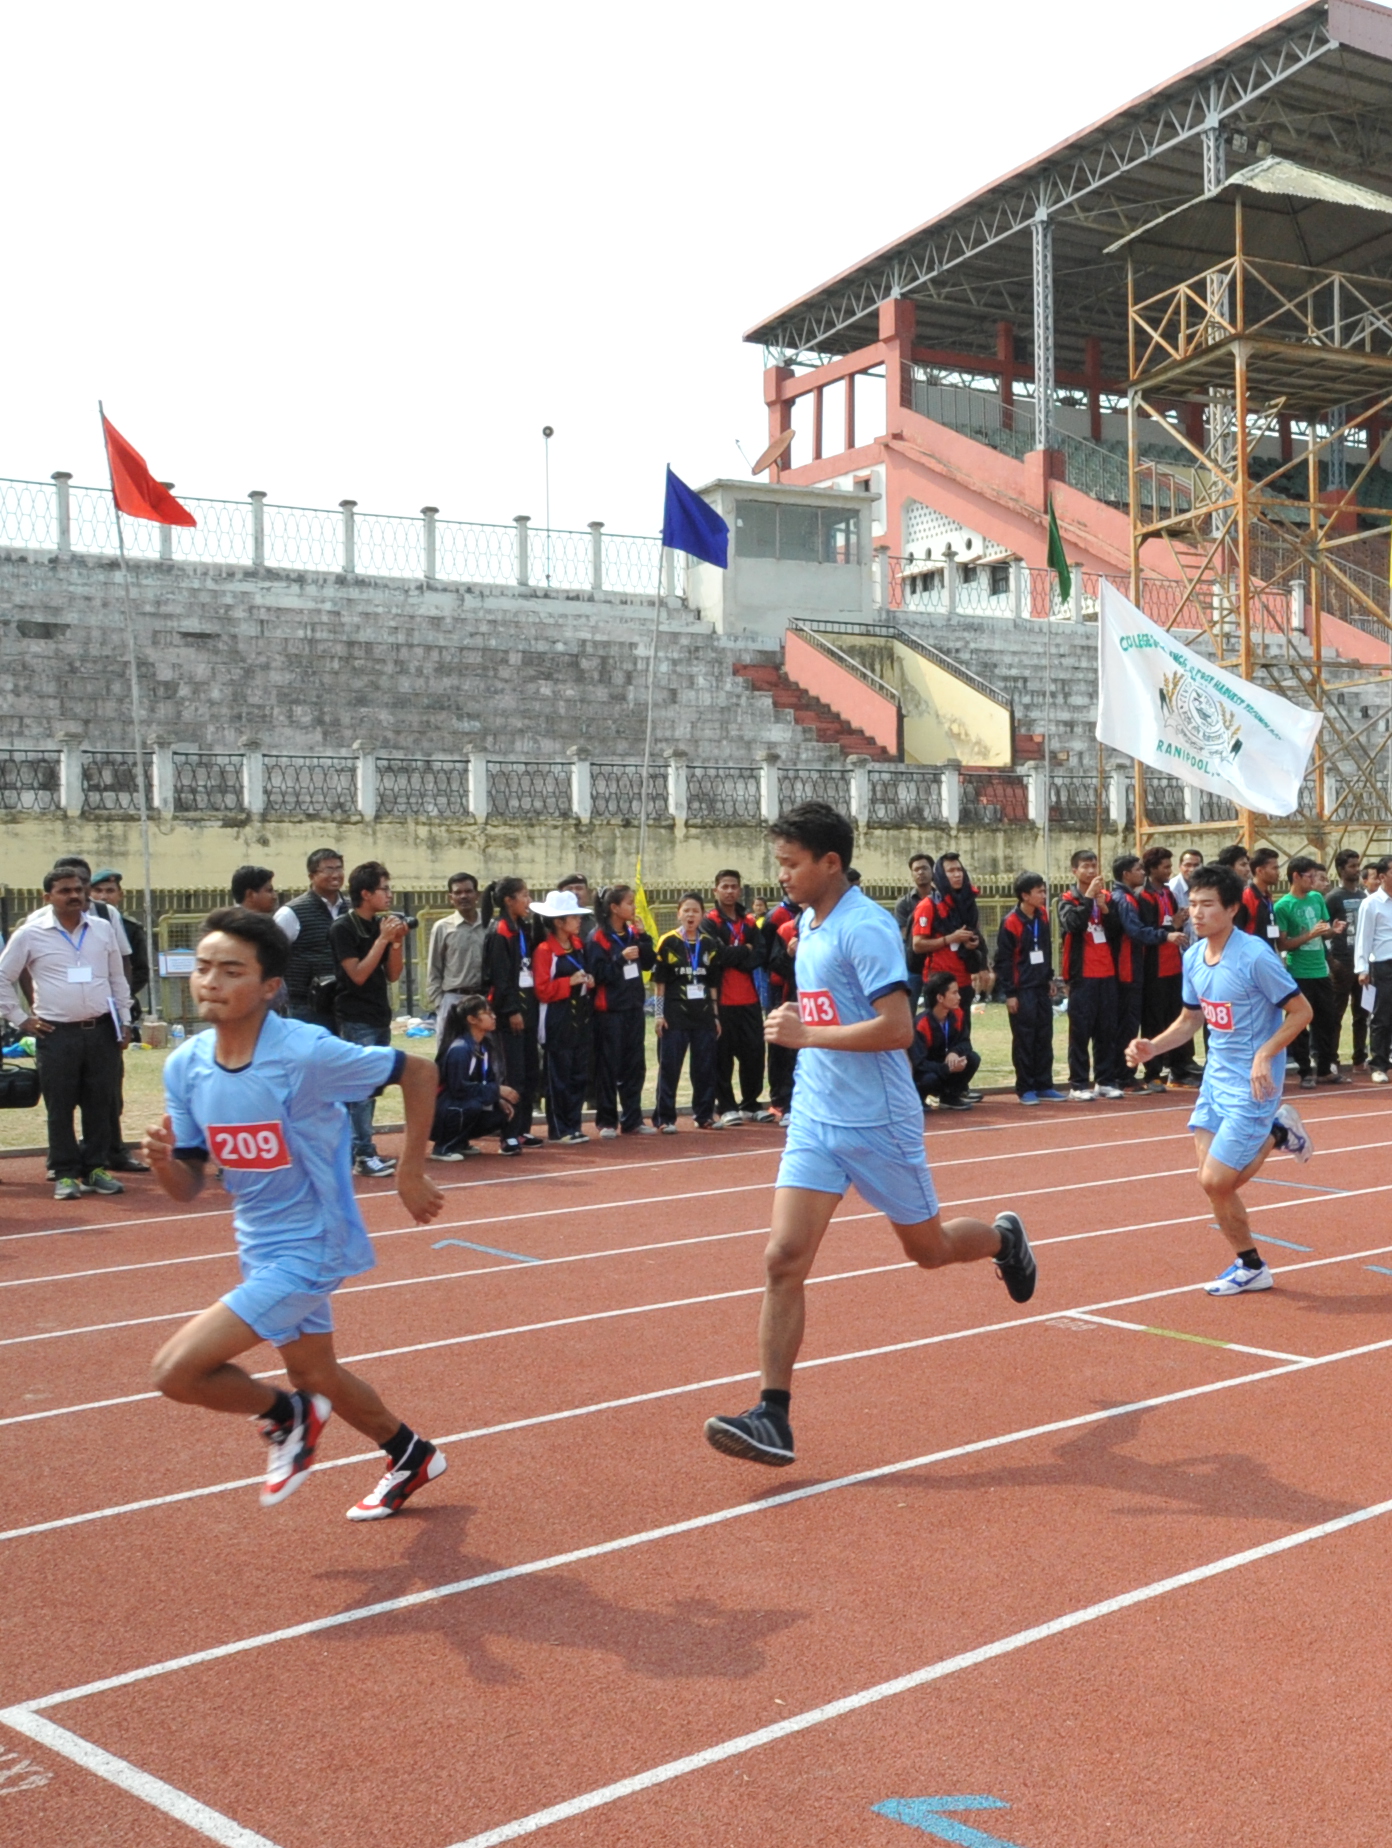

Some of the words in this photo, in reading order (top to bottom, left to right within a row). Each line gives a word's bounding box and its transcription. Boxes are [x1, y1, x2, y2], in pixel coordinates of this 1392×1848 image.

[1213, 680, 1246, 706] HARVEST
[802, 996, 834, 1022] 213
[215, 1131, 279, 1160] 209
